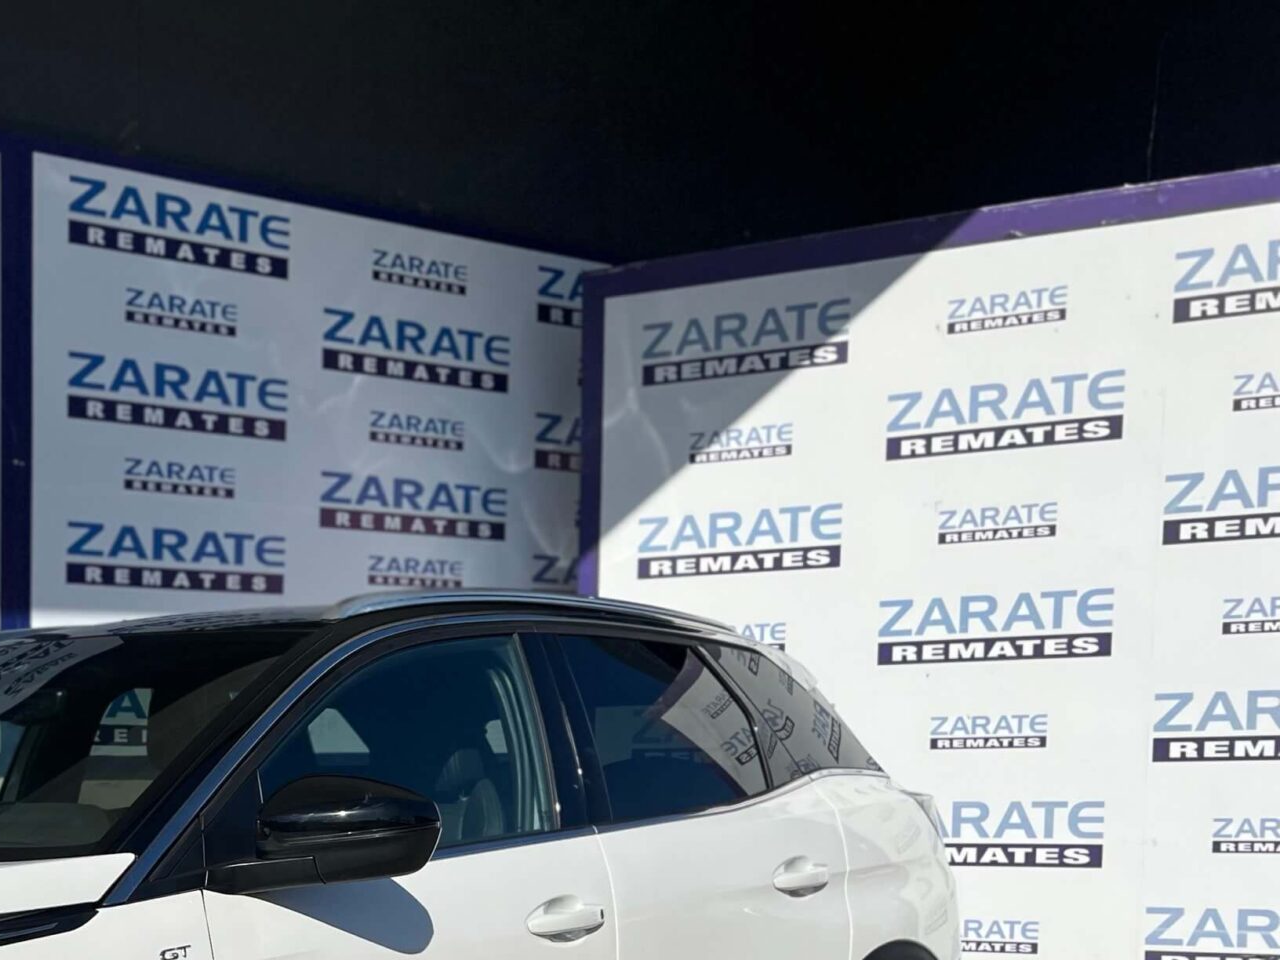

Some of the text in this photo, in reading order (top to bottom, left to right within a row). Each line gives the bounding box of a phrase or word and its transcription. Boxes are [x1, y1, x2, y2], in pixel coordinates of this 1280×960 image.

[69, 175, 291, 250] ZARATE
[88, 225, 273, 274] REMATES
[372, 249, 468, 283] ZARATE
[125, 288, 238, 322] ZARATE
[947, 285, 1068, 320] ZARATE
[323, 306, 510, 366] ZARATE
[641, 298, 851, 360] ZARATE
[68, 351, 288, 412] ZARATE
[338, 352, 495, 390] REMATES
[652, 344, 838, 384] REMATES
[886, 369, 1126, 433] ZARATE
[86, 400, 270, 438] REMATES
[370, 410, 464, 438] ZARATE
[689, 423, 793, 451] ZARATE
[898, 419, 1112, 457] REMATES
[124, 458, 236, 486] ZARATE
[320, 471, 508, 517] ZARATE
[1163, 465, 1280, 515] ZAR
[335, 510, 492, 537] REMATES
[637, 503, 843, 553] ZARATE
[938, 502, 1058, 530] ZARATE
[67, 521, 286, 567] ZARATE
[84, 565, 268, 592] REMATES
[368, 555, 464, 576] ZARATE
[648, 549, 830, 576] REMATES
[878, 588, 1114, 637] ZARATE
[741, 622, 786, 642] ATE
[891, 636, 1100, 663] REMATES
[930, 713, 1048, 736] ZARATE
[1153, 690, 1280, 732] ZAR
[939, 800, 1104, 839] RATE
[1212, 818, 1280, 838] ZAR
[946, 847, 1090, 864] MATES
[963, 919, 1039, 940] RATE
[1145, 906, 1280, 949] ZAR
[160, 944, 191, 960] GT
[961, 941, 1033, 954] MATES
